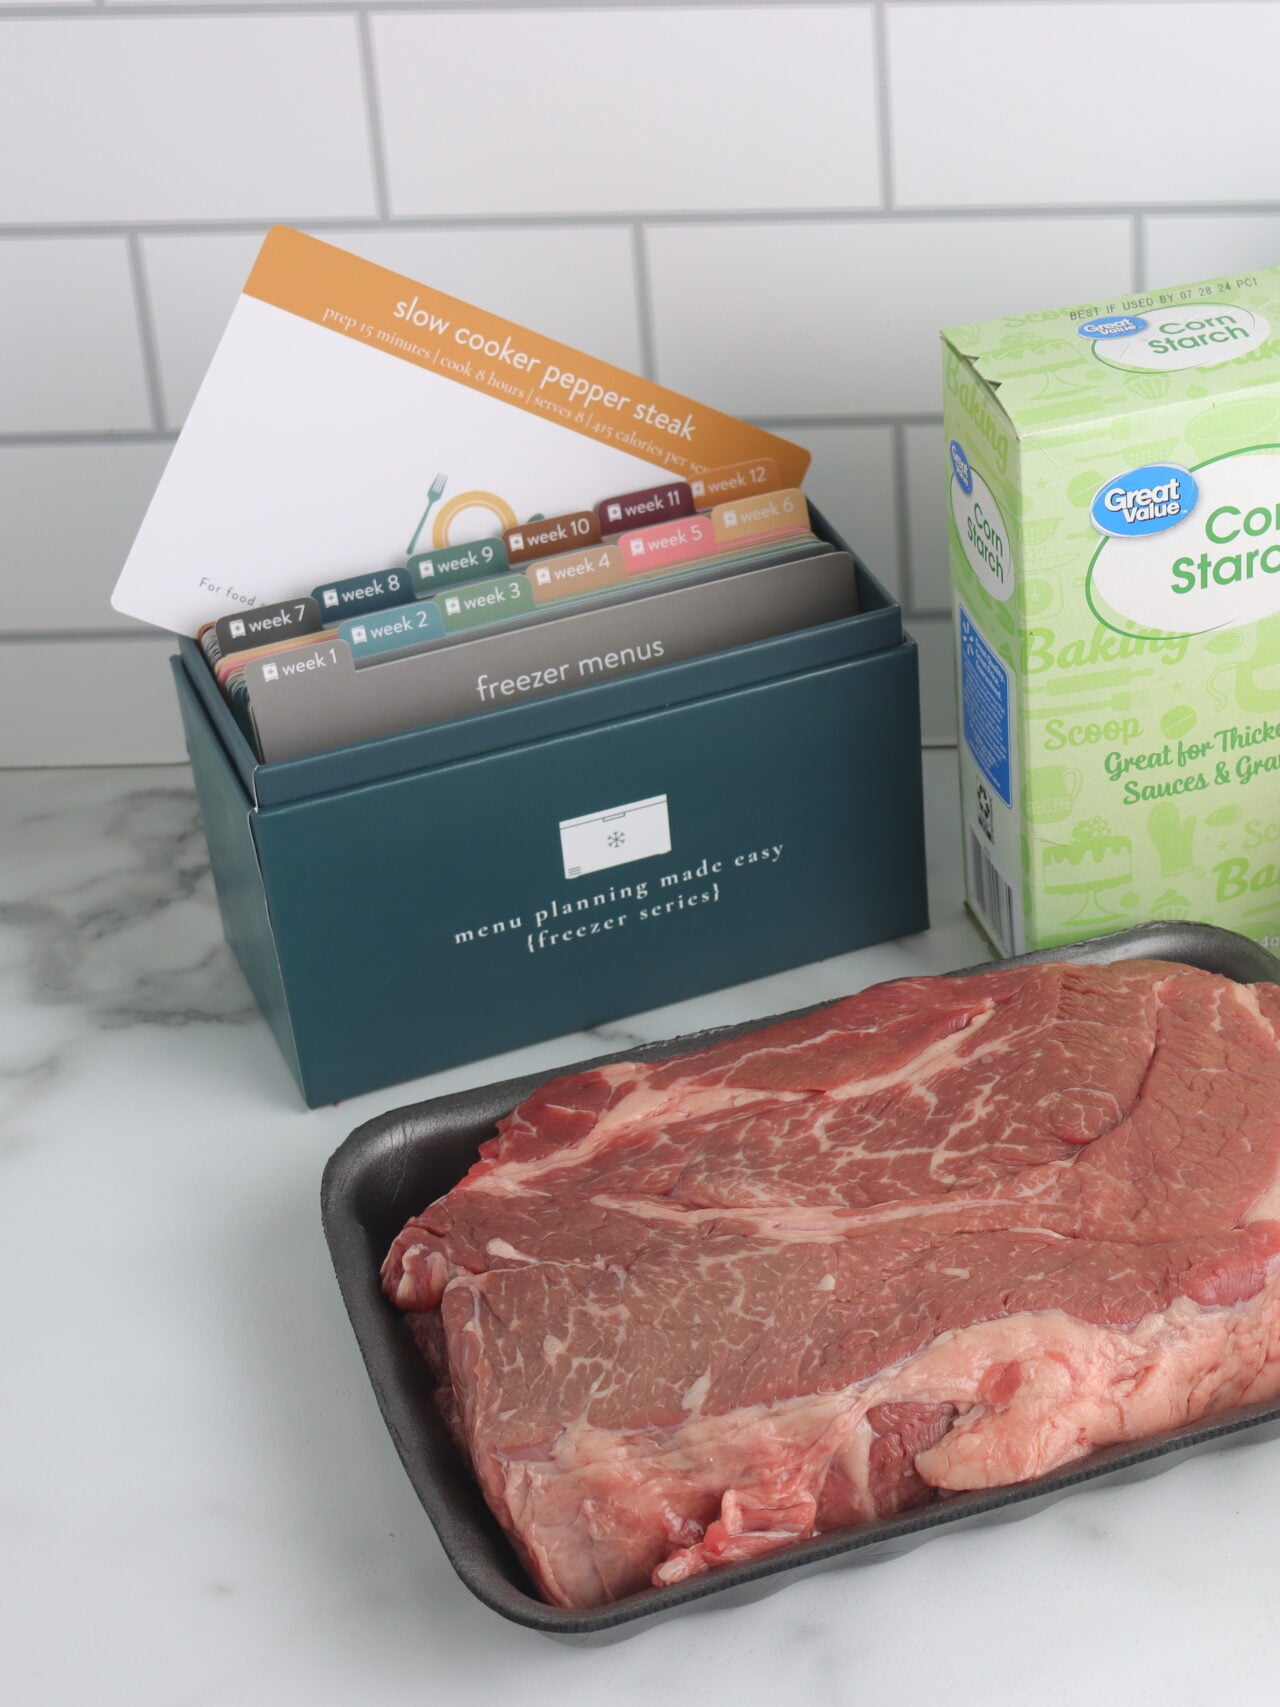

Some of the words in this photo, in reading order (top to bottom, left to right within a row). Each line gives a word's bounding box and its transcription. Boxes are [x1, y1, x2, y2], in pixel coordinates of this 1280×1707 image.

[1069, 309, 1103, 322] BEST
[1107, 304, 1116, 315] IF
[1123, 298, 1154, 310] USED
[1160, 293, 1174, 305] BY
[1180, 289, 1192, 300] 07
[1199, 285, 1213, 297] 28
[1218, 282, 1232, 293] 24
[1083, 316, 1134, 334] Great
[1101, 323, 1137, 337] Value
[1159, 311, 1236, 336] Corn
[1147, 326, 1250, 356] Starch
[393, 296, 450, 335] slow
[454, 328, 541, 374] cooker
[539, 365, 630, 408] pepper
[633, 403, 696, 442] steak
[322, 307, 357, 331] prep
[360, 323, 374, 338] 15
[376, 331, 432, 359] minutes
[440, 357, 473, 378] cook
[475, 369, 486, 382] 8
[487, 371, 525, 398] hours
[534, 394, 572, 417] serves
[574, 410, 585, 422] 8
[592, 421, 614, 438] 415
[614, 430, 663, 457] calories
[664, 451, 689, 467] per
[708, 472, 746, 494] week
[750, 466, 766, 483] 12
[624, 495, 664, 516] week
[667, 490, 680, 506] 11
[741, 501, 780, 523] week
[783, 497, 795, 513] 6
[1104, 478, 1181, 513] Great
[1122, 501, 1180, 524] Value
[526, 525, 568, 546] week
[570, 518, 590, 536] 10
[648, 530, 687, 551] week
[691, 524, 703, 541] 5
[973, 502, 1004, 558] Corn
[437, 552, 479, 574] week
[482, 546, 493, 563] 9
[967, 516, 1004, 584] Starch
[554, 559, 595, 580] week
[598, 553, 611, 569] 4
[199, 577, 221, 594] For
[226, 586, 256, 606] food
[342, 579, 384, 603] week
[388, 575, 400, 591] 8
[464, 587, 506, 610] week
[508, 582, 521, 598] 3
[249, 610, 292, 633] week
[294, 604, 306, 622] 7
[370, 616, 414, 639] week
[416, 611, 428, 628] 2
[282, 652, 327, 676] week
[330, 648, 337, 664] 1
[1020, 620, 1190, 675] Baking
[476, 663, 570, 701] freezer
[578, 640, 664, 676] menus
[1043, 718, 1144, 751] Scoop
[1104, 745, 1173, 781] Great
[1178, 741, 1213, 767] for
[1122, 774, 1209, 805] Sauces
[1214, 761, 1231, 785] &
[453, 916, 522, 945] menu
[534, 882, 649, 928] planning
[659, 859, 723, 888] made
[734, 844, 784, 867] easy
[527, 913, 628, 953] {freezer
[639, 883, 720, 921] series}
